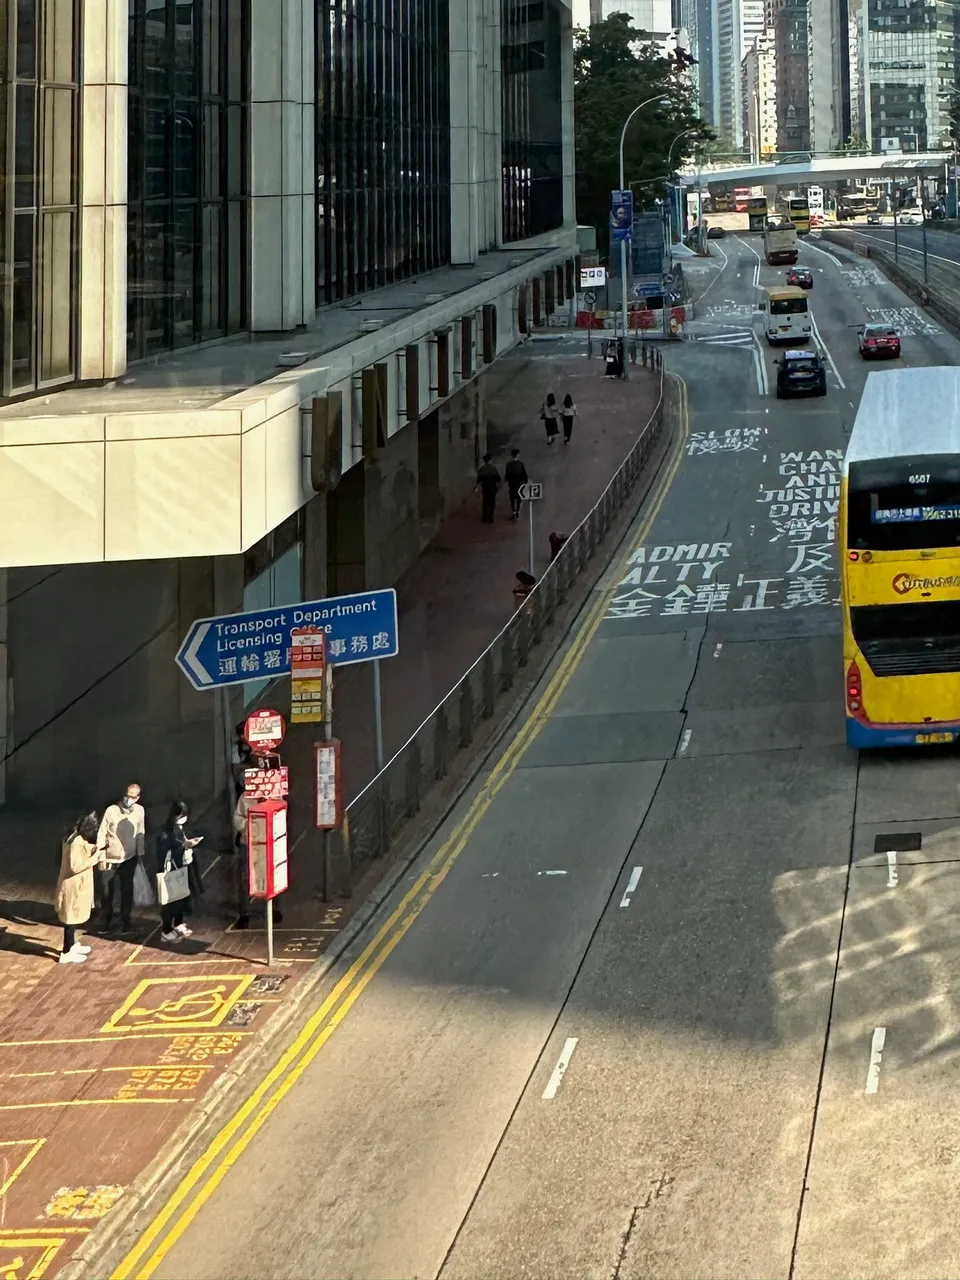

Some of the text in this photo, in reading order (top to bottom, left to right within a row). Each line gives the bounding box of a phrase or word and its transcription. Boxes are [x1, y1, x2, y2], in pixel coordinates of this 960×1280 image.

[690, 427, 761, 440] SLOW
[780, 449, 843, 463] WAN
[756, 485, 840, 502] JUSTI
[769, 500, 839, 518] DRIV
[626, 542, 733, 565] ADMIR
[785, 542, 834, 574] 及
[617, 561, 724, 585] ALTY
[215, 599, 377, 637] Transport Department
[217, 631, 283, 653] Licensing
